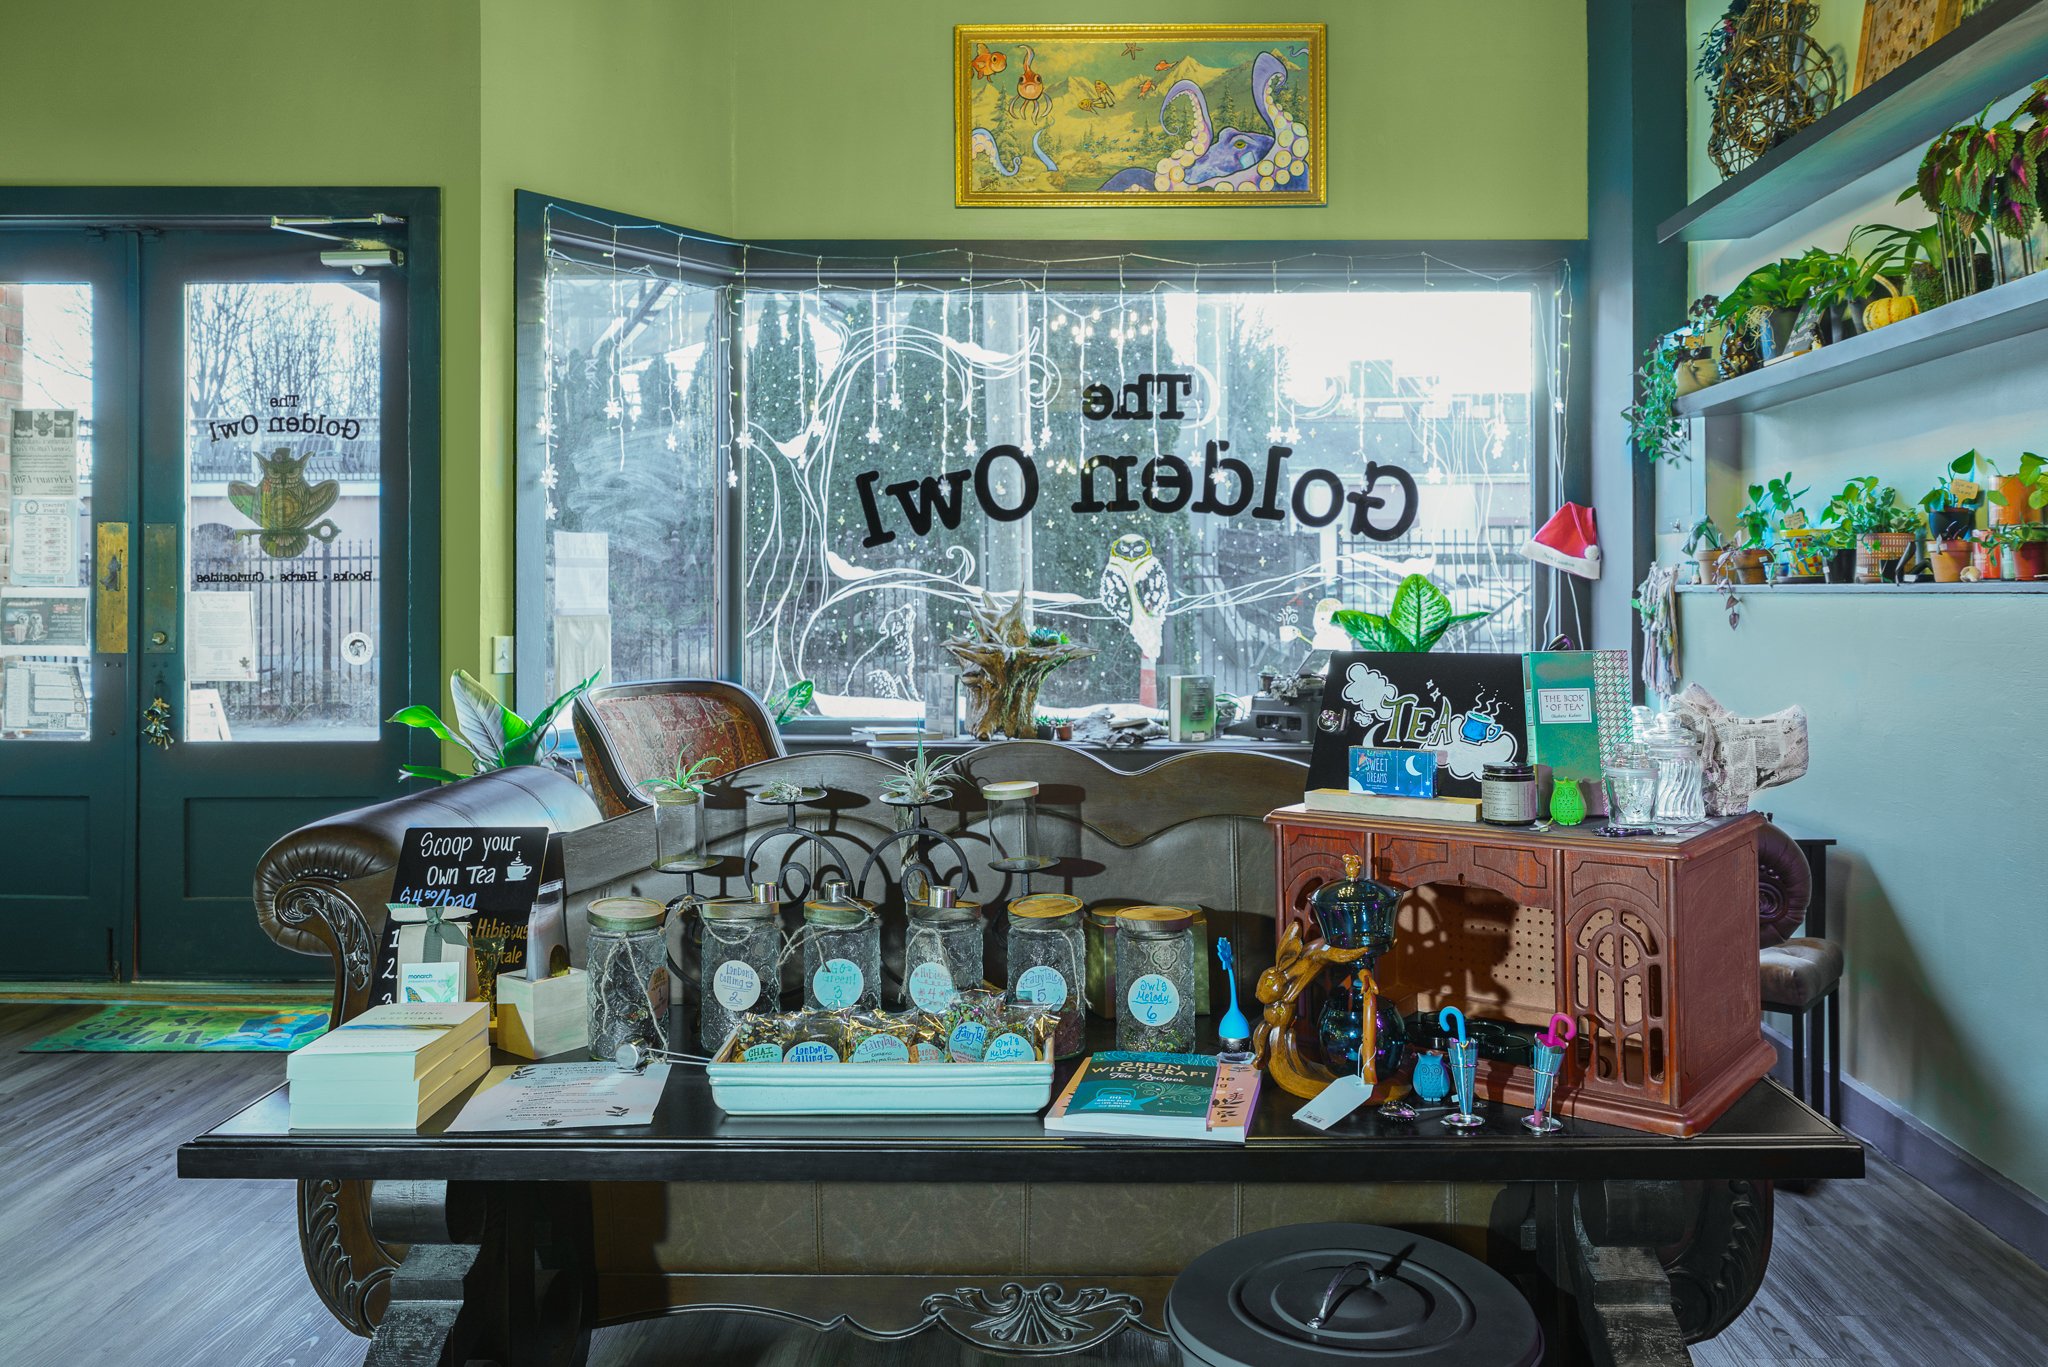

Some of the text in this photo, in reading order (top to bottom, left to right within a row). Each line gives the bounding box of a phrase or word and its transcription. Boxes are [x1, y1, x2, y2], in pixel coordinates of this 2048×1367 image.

[1543, 694, 1585, 703] THE BOOK
[1550, 703, 1582, 711] OF TEA
[1380, 693, 1454, 746] TEA
[1365, 757, 1389, 772] SWEET
[1366, 772, 1388, 784] DREAMS
[420, 831, 521, 862] Scoop your
[426, 865, 496, 886] Own Tea
[408, 972, 433, 980] monarch
[1140, 978, 1168, 992] Owl's
[729, 991, 743, 1003] 2
[833, 985, 843, 999] 3
[928, 987, 936, 999] 4
[1037, 988, 1047, 1003] 5
[1136, 990, 1170, 1005] Melody
[1146, 1005, 1158, 1020] 6
[955, 1025, 986, 1045] FairyTal
[995, 1036, 1020, 1048] Owl's
[748, 1046, 773, 1057] CHAI
[990, 1047, 1024, 1058] Melody
[1092, 1066, 1209, 1078] WITCHCRAFT
[1120, 1061, 1182, 1071] GREEN
[1109, 1071, 1186, 1083] Tea Recipes
